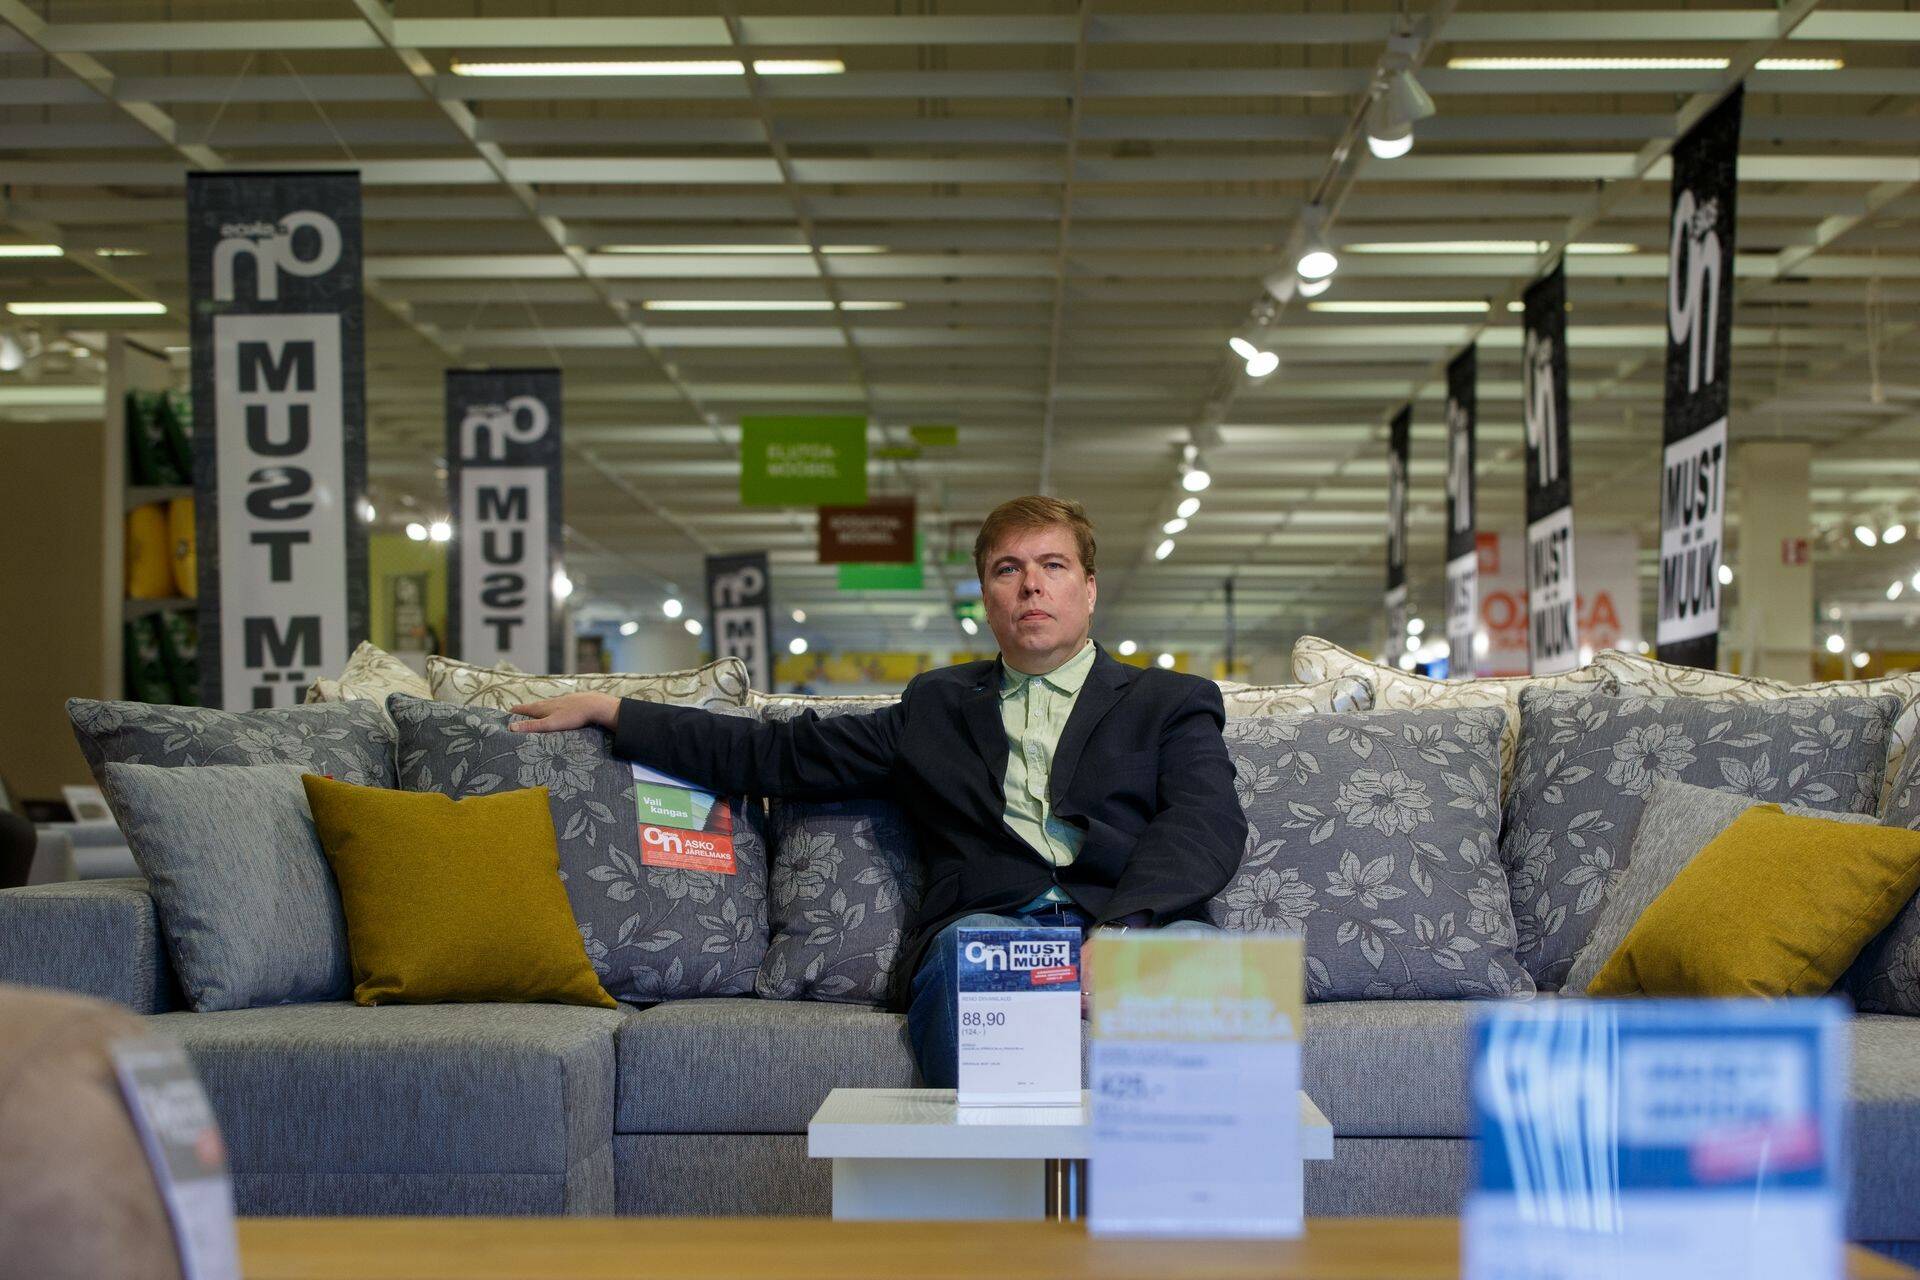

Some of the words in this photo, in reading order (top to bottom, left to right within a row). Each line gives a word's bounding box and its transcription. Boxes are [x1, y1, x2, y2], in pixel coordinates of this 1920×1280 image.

[1663, 443, 1722, 531] MUST
[643, 796, 662, 806] Vali
[650, 805, 688, 818] kangas
[684, 839, 714, 851] ASKO
[685, 848, 732, 860] JÄRELMAKS
[1014, 944, 1066, 955] MUST
[1014, 954, 1066, 968] MÜÜK
[962, 1012, 1005, 1028] 88,90
